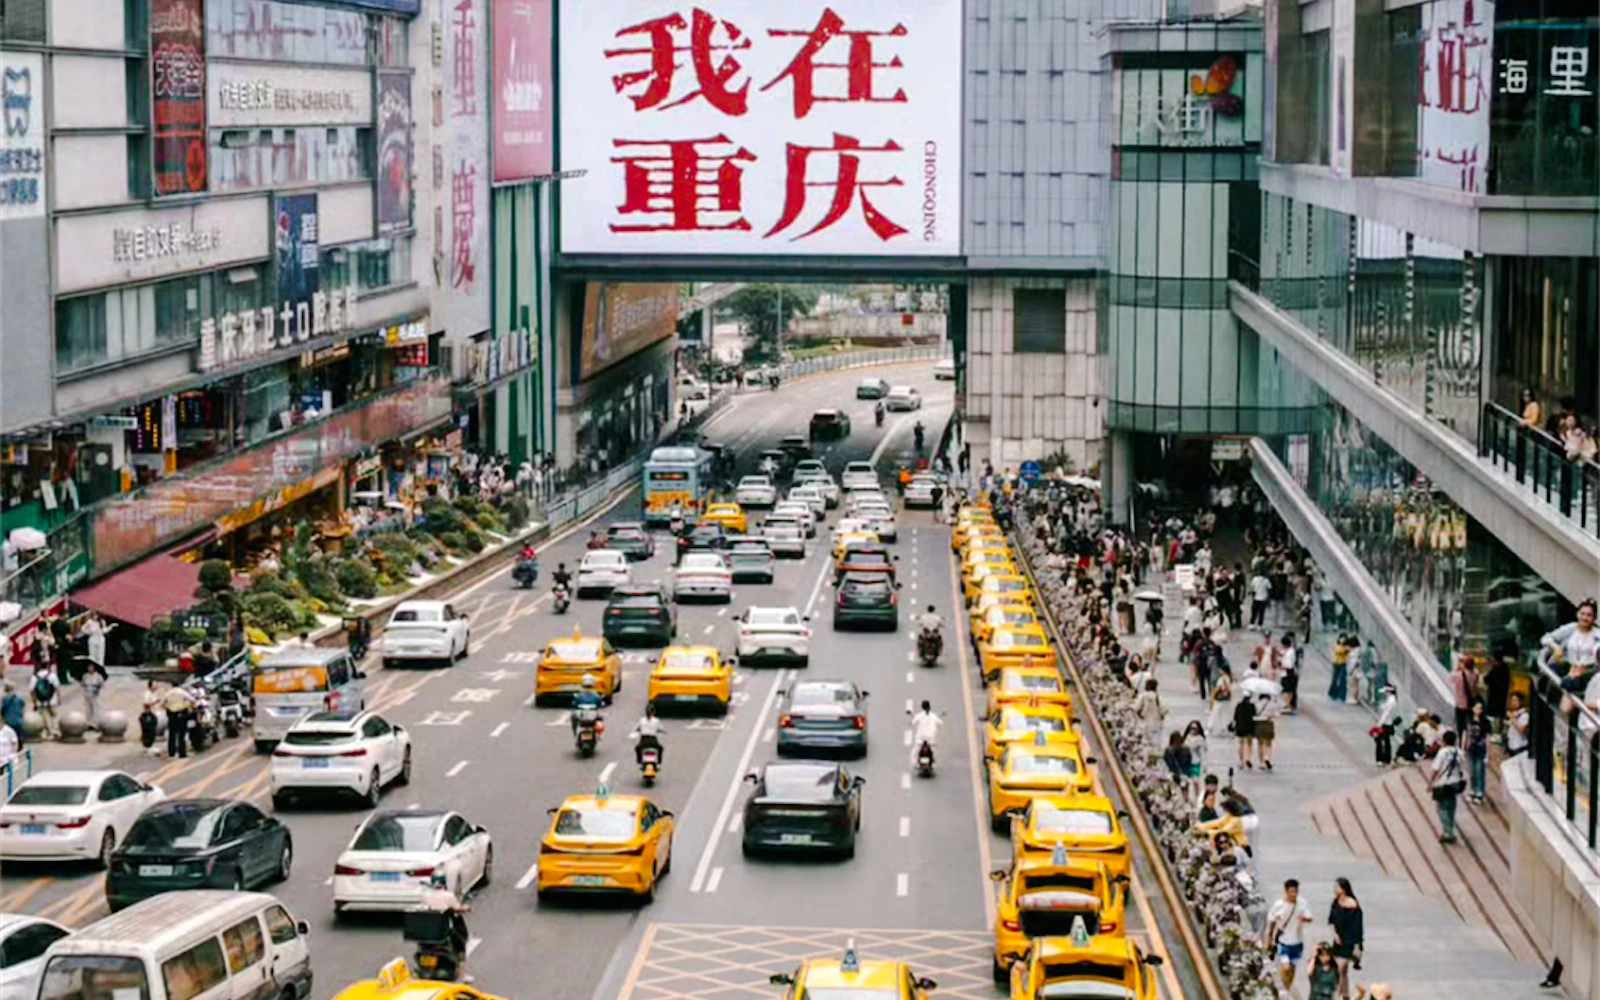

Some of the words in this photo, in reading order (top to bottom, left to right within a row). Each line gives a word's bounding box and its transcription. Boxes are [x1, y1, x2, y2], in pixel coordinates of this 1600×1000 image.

[603, 7, 908, 119] 我在
[608, 132, 910, 242] 重庆
[923, 140, 938, 242] CHONGQING
